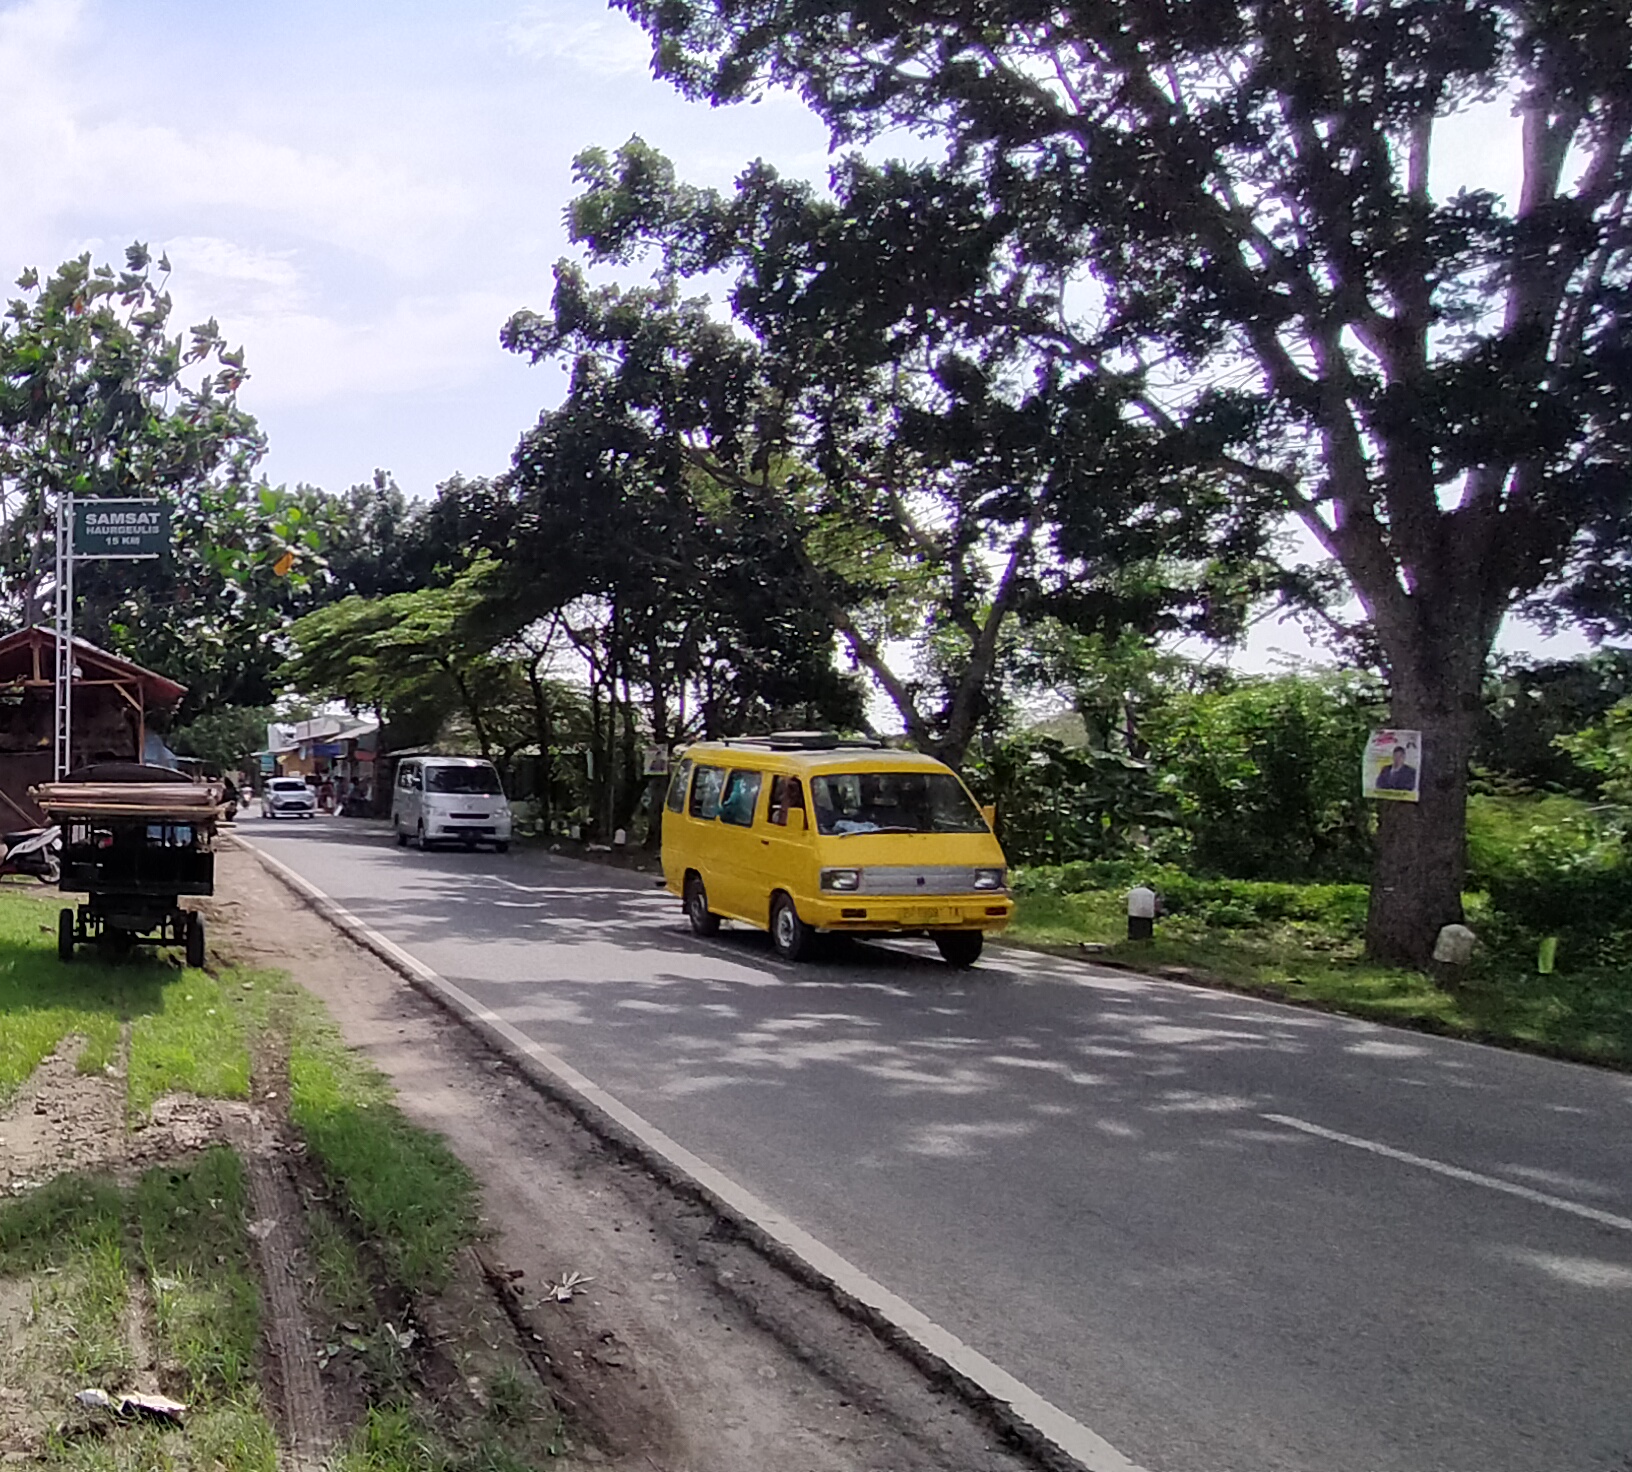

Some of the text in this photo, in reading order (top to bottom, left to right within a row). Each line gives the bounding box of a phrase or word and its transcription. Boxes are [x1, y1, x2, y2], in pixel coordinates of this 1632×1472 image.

[85, 512, 161, 525] SAMSAT
[86, 525, 160, 535] HAURGEULIS
[105, 536, 141, 546] 15 KM
